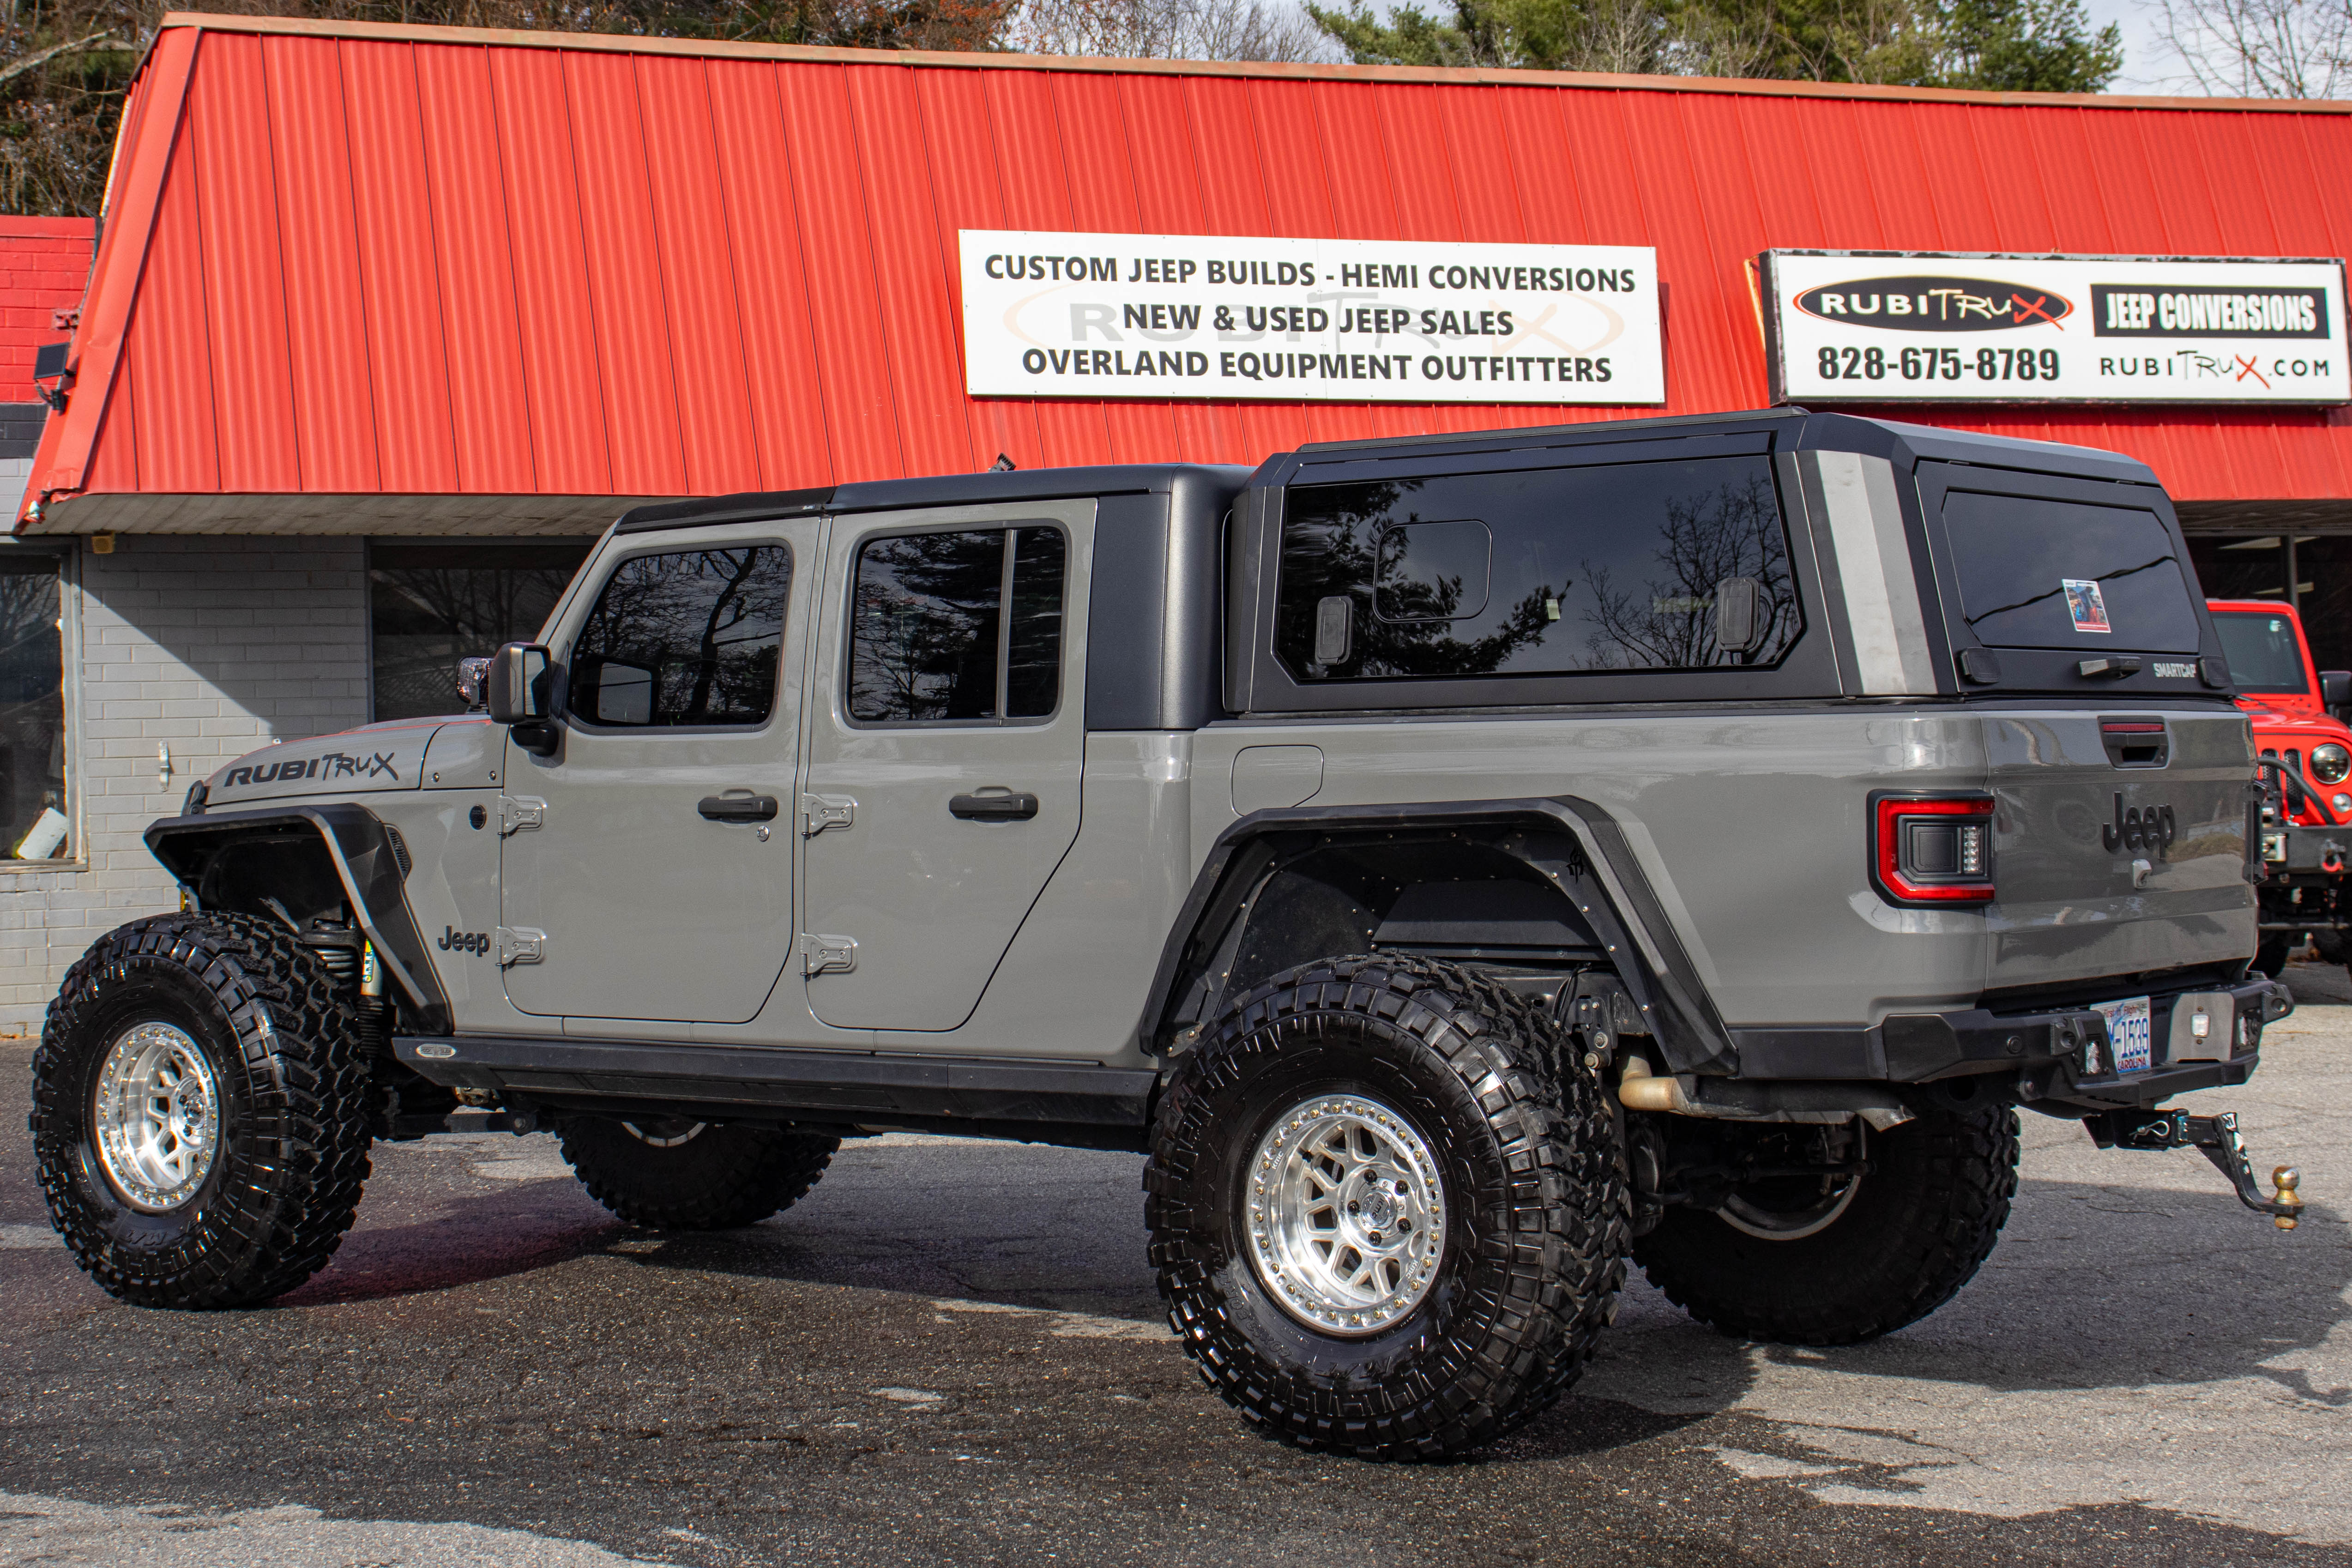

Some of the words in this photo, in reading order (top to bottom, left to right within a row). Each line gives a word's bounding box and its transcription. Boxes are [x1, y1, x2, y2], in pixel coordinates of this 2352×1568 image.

[985, 254, 1117, 282] CUSTOM
[1128, 259, 1196, 283] JEEP
[1207, 260, 1315, 286] BUILDS
[1341, 264, 1418, 288] HEMI
[1429, 265, 1634, 293] CONVERSIONS
[1123, 303, 1201, 330] NEW
[1213, 305, 1236, 331] &
[1246, 306, 1328, 332] USED
[1339, 308, 1410, 334] JEEP
[1420, 310, 1514, 336] SALES
[2106, 292, 2156, 330] JEEP
[2158, 293, 2317, 332] CONVERSIONS
[1022, 348, 1208, 376] OVERLAND
[1220, 352, 1412, 381] EQUIPMENT
[1421, 356, 1611, 383] OUTFITTERS
[1818, 347, 2061, 381] 828-675-8789
[2153, 663, 2196, 678] SMARTCAP
[2102, 791, 2176, 860] Jeep
[437, 925, 490, 957] Jeep
[2117, 1056, 2147, 1072] CAROLINA
